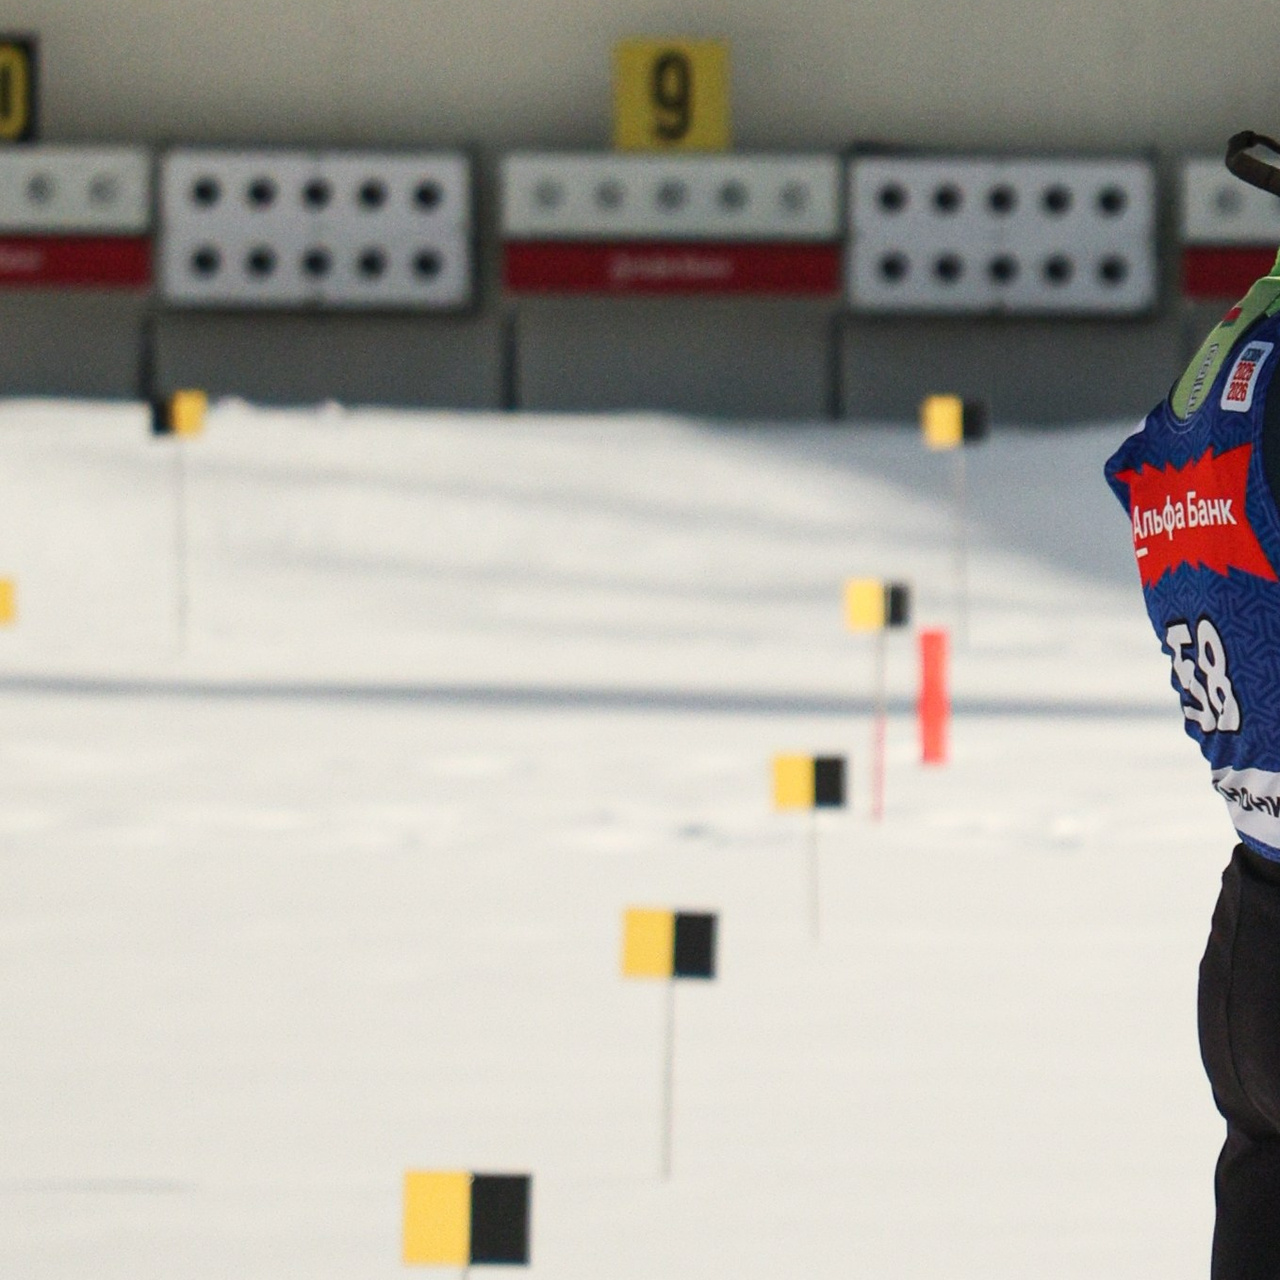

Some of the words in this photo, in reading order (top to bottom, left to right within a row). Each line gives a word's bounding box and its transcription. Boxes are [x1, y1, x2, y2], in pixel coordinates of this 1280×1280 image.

[648, 52, 695, 142] 9
[1133, 494, 1186, 543] Альфа
[1186, 490, 1238, 528] Банк
[1165, 618, 1241, 734] 58
